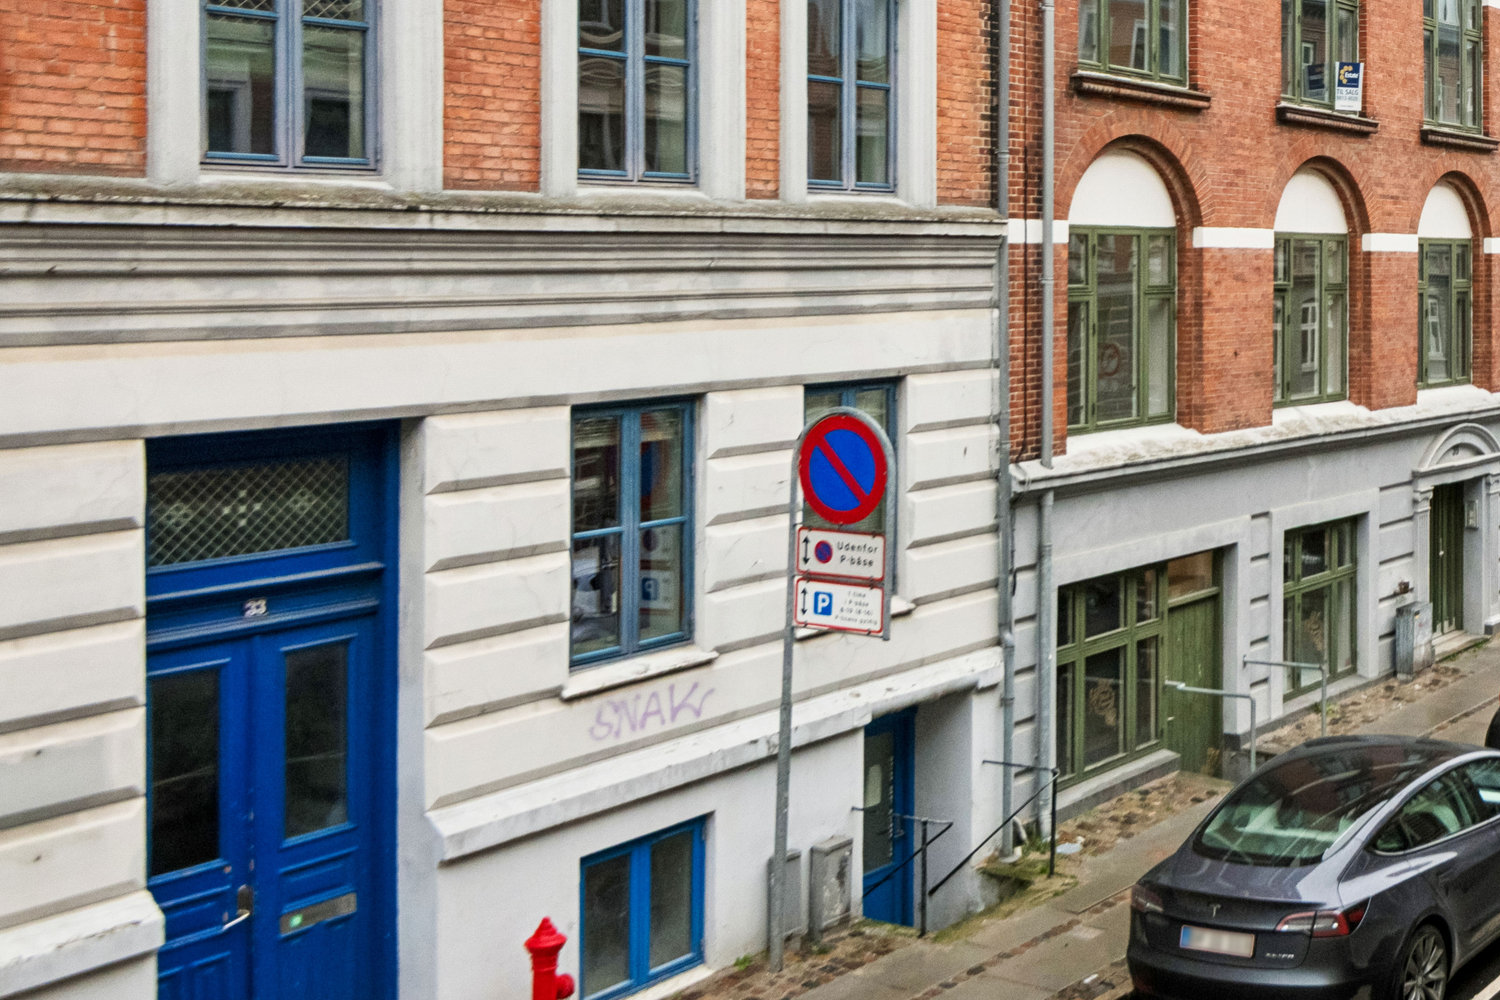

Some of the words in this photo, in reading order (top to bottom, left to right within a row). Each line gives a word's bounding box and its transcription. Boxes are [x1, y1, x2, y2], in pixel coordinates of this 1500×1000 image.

[837, 541, 878, 554] Udenfor
[840, 554, 874, 567] P-båse
[817, 593, 830, 613] P
